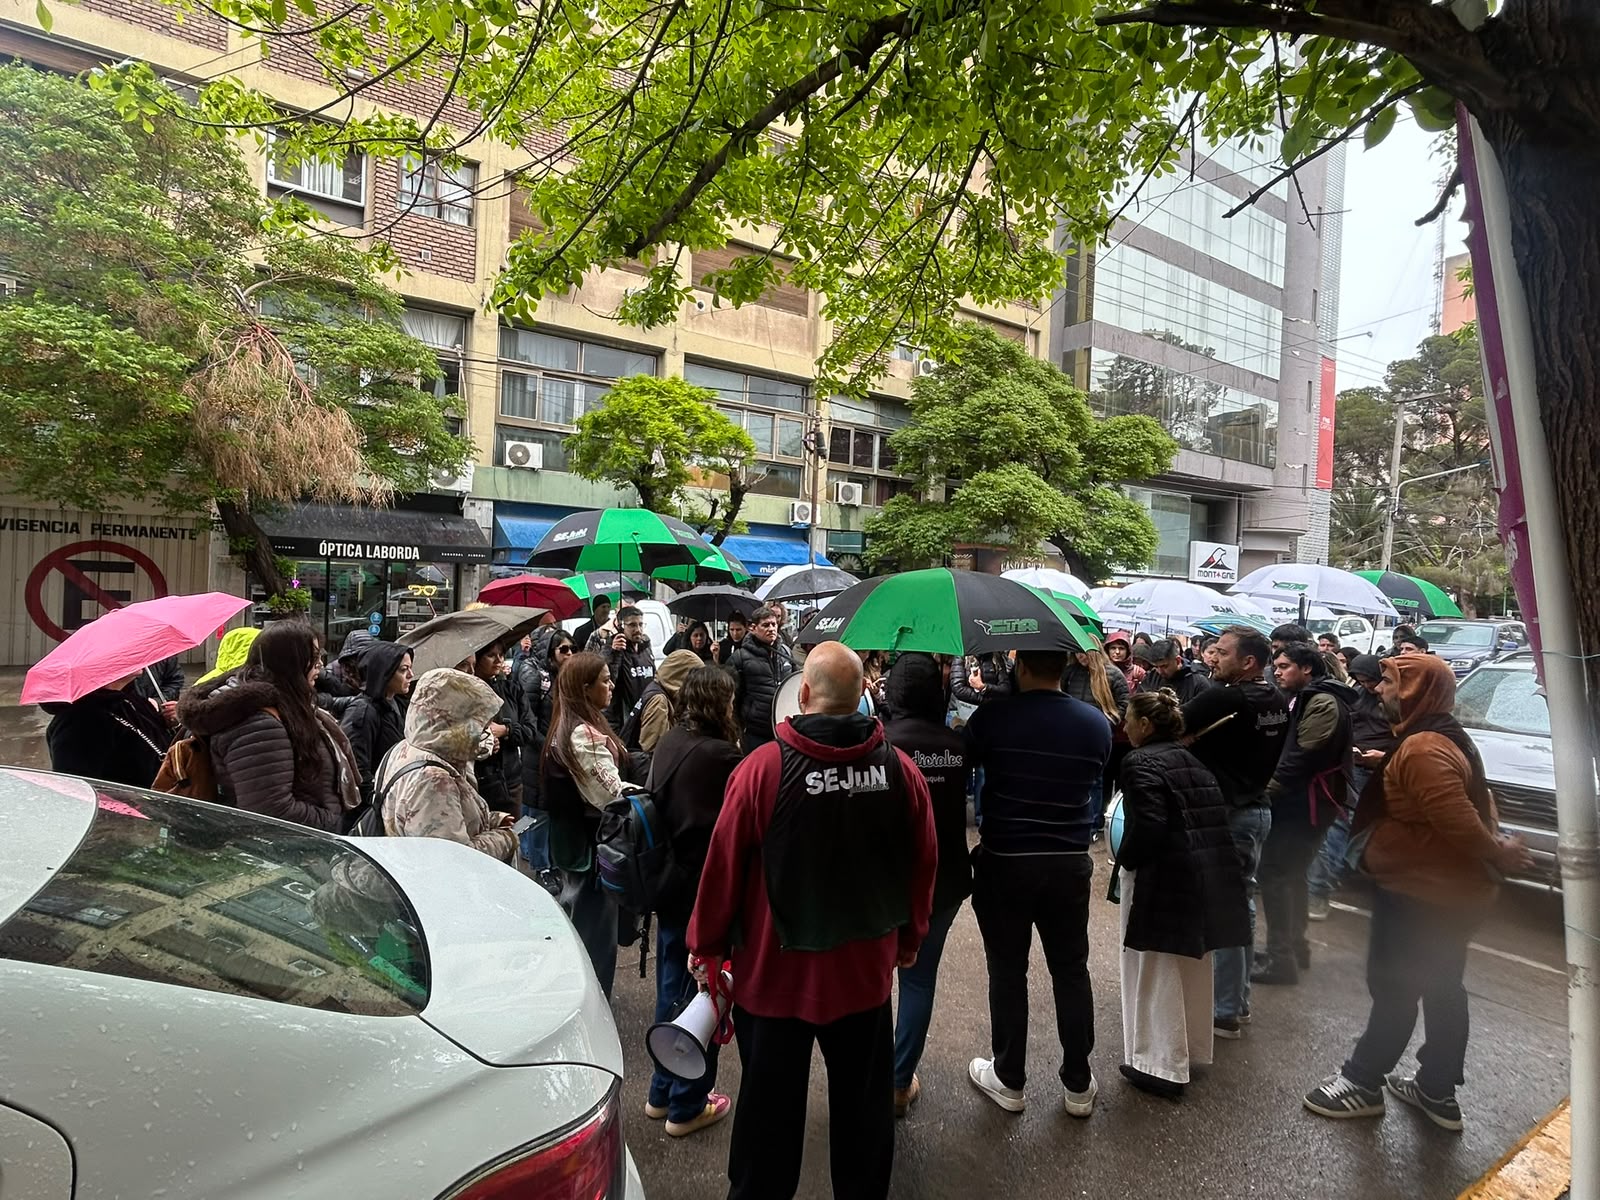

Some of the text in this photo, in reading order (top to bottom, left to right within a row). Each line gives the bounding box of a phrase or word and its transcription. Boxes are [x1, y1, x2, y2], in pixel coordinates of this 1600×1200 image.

[0, 518, 197, 541] VIGENCIA PERMANENTE
[319, 539, 420, 560] ÓPTICA LABORDA
[912, 749, 963, 768] diciales
[925, 775, 946, 784] uquén
